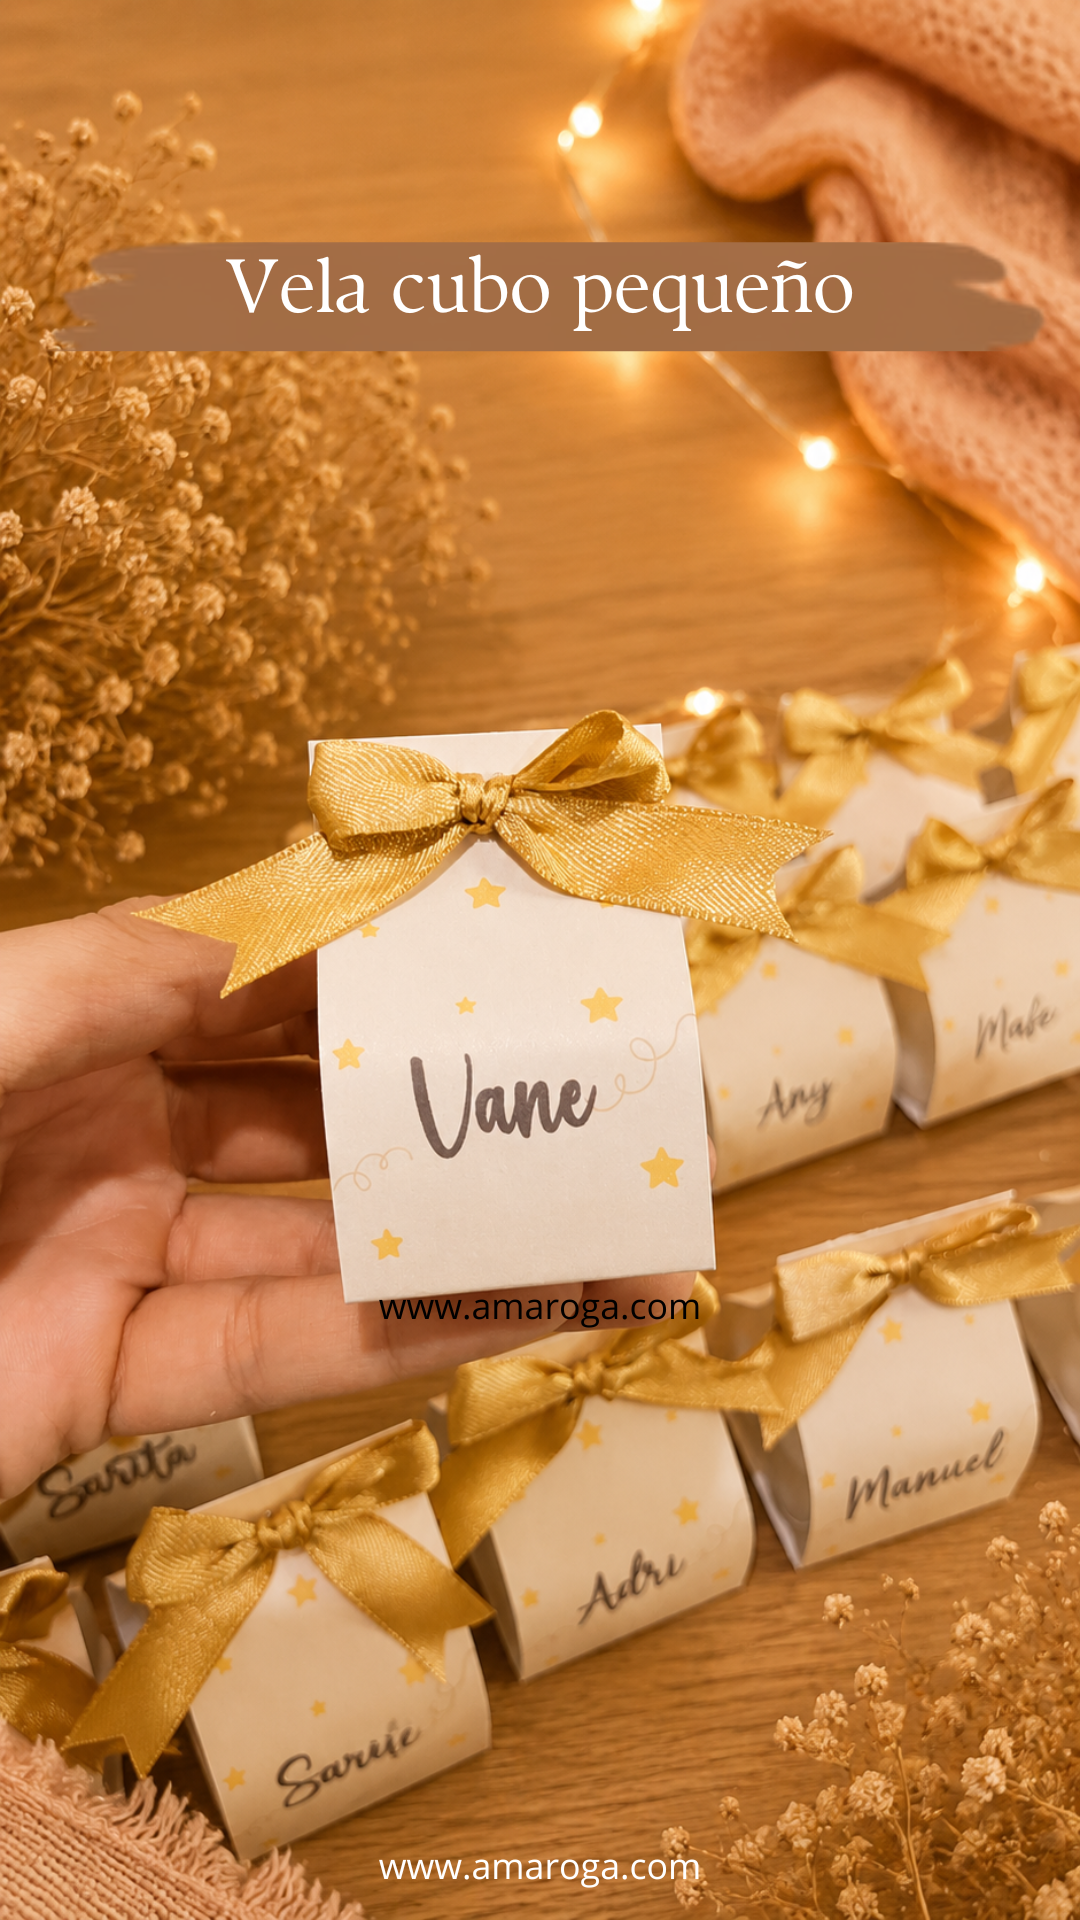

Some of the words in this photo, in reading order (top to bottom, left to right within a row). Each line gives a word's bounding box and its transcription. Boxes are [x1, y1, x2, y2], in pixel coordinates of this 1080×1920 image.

[410, 1053, 598, 1159] Vane
[756, 1077, 833, 1130] Any
[846, 1426, 1006, 1520] Manuel
